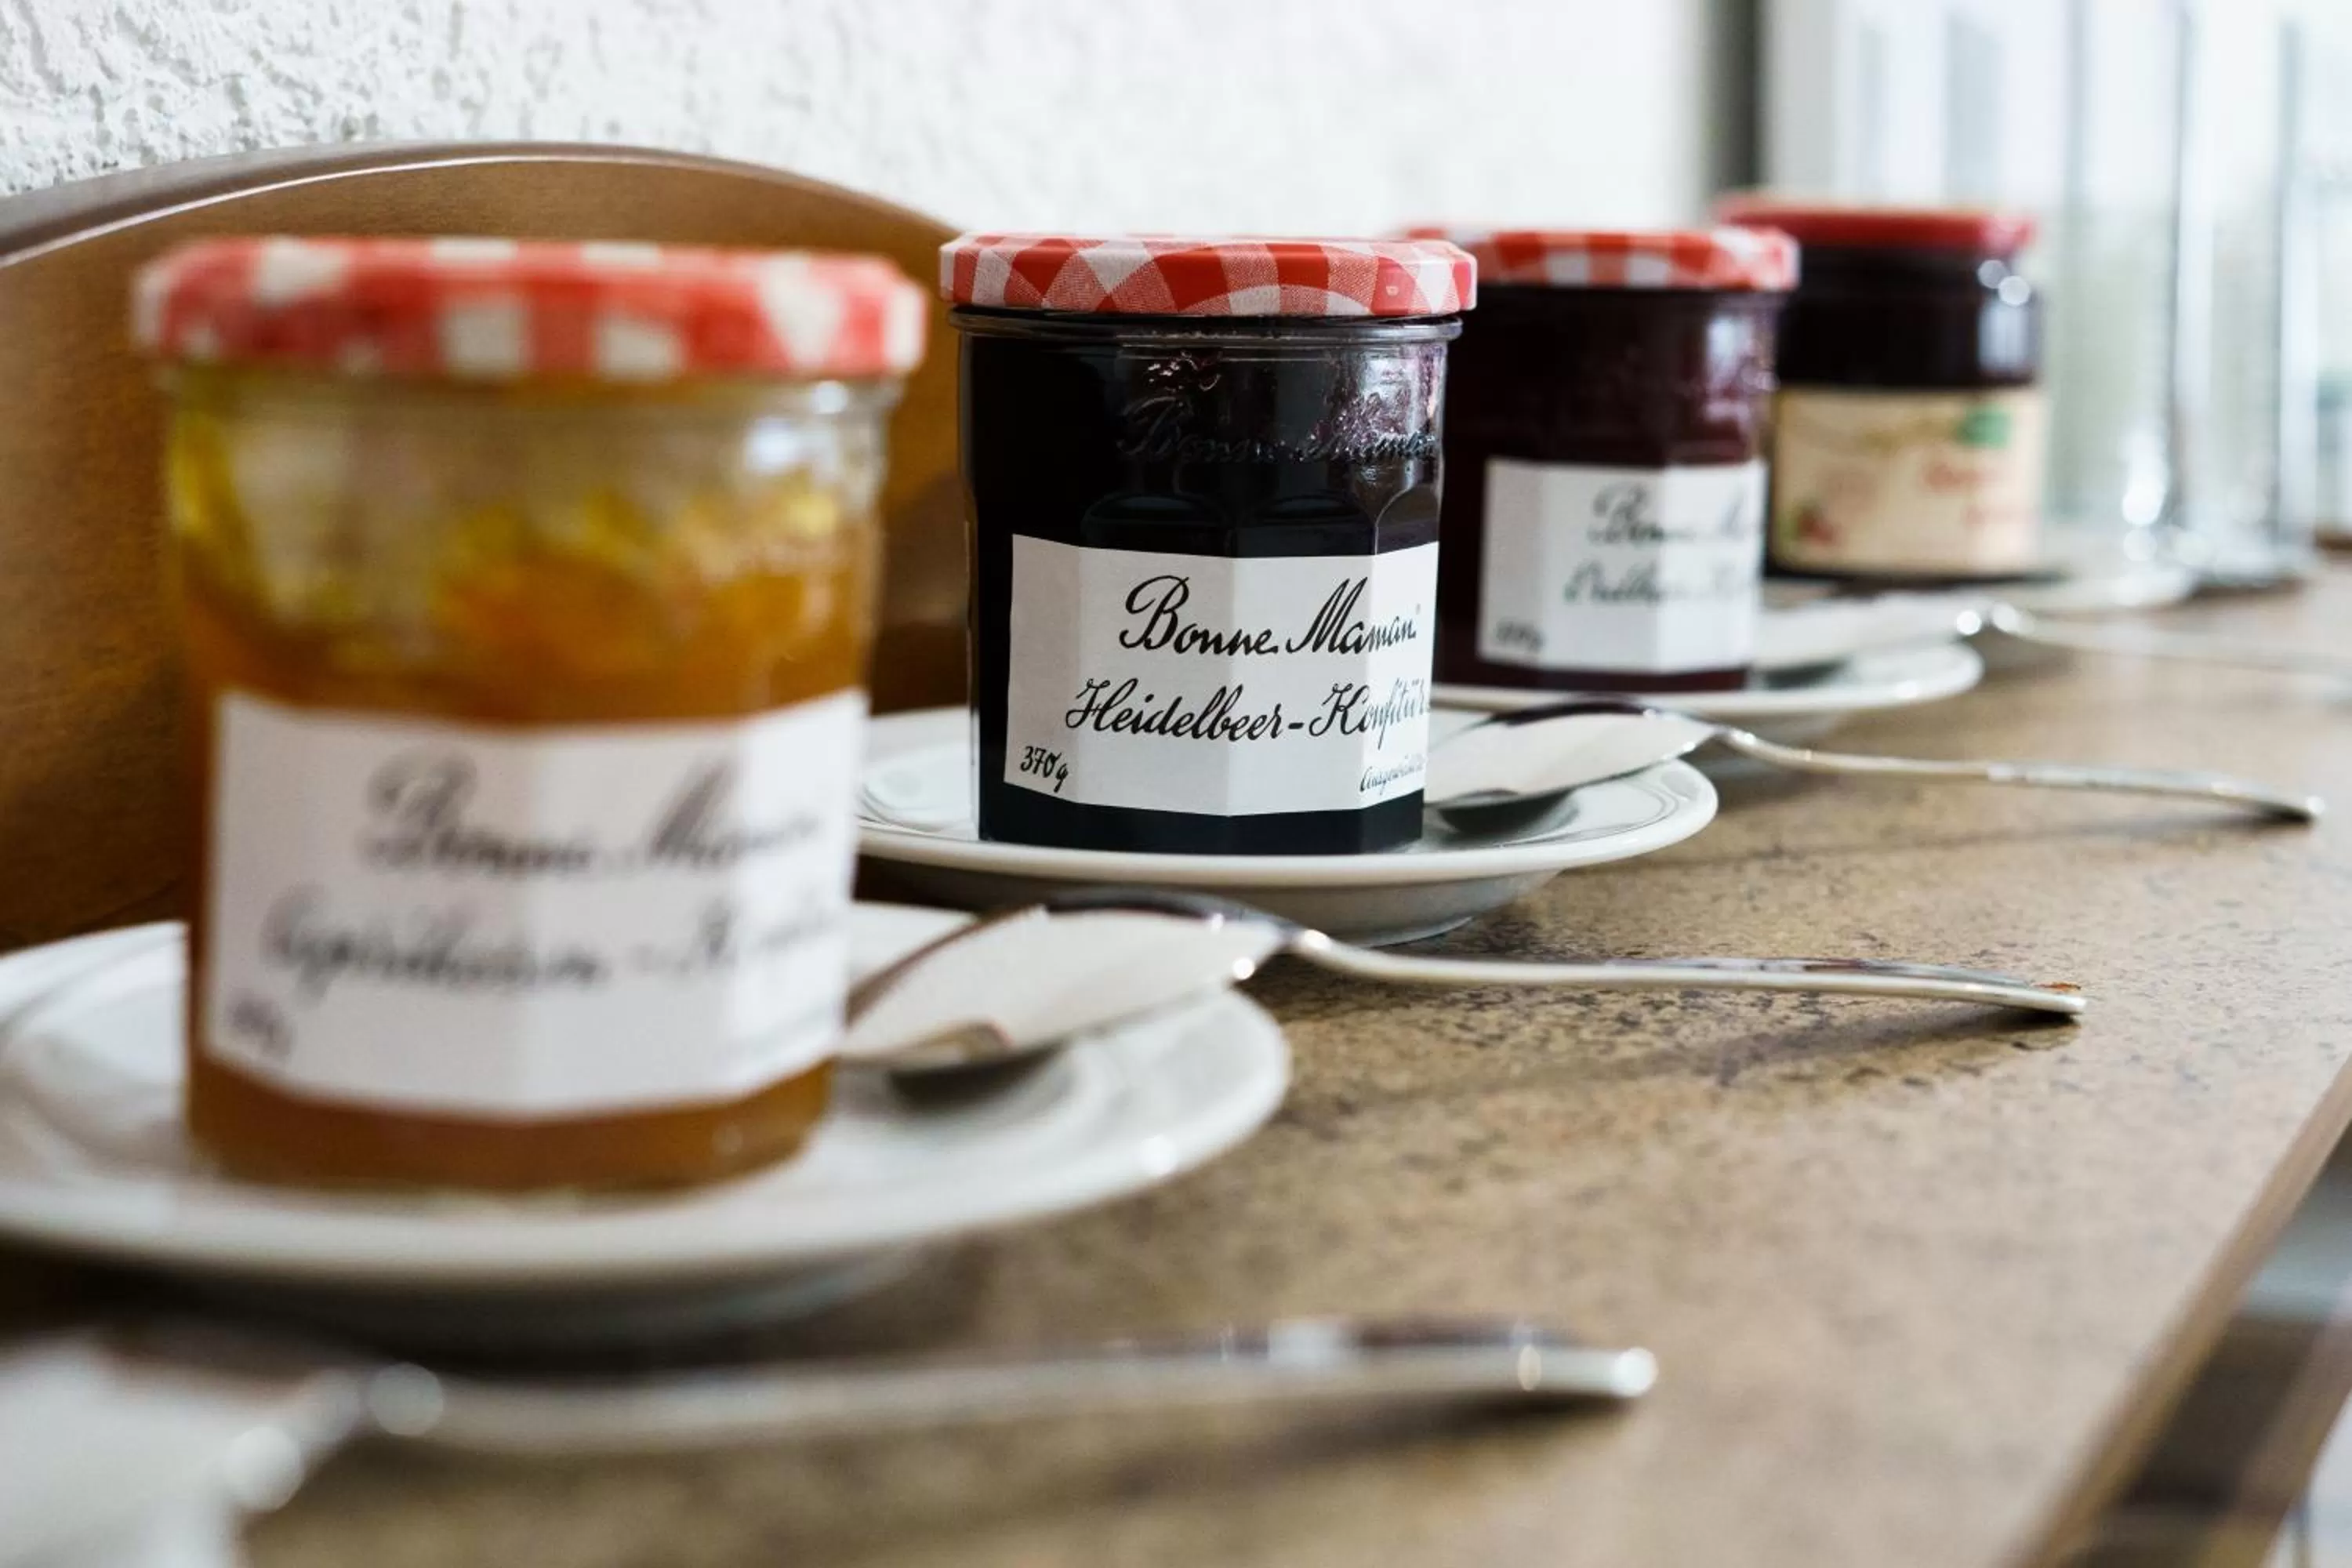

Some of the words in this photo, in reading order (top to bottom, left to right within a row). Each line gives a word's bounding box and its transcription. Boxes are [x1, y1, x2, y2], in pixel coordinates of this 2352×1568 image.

[1118, 574, 1279, 657] Bonne
[1284, 576, 1417, 655] Maman
[1065, 677, 1425, 751] Heidelbeer-Konfitür
